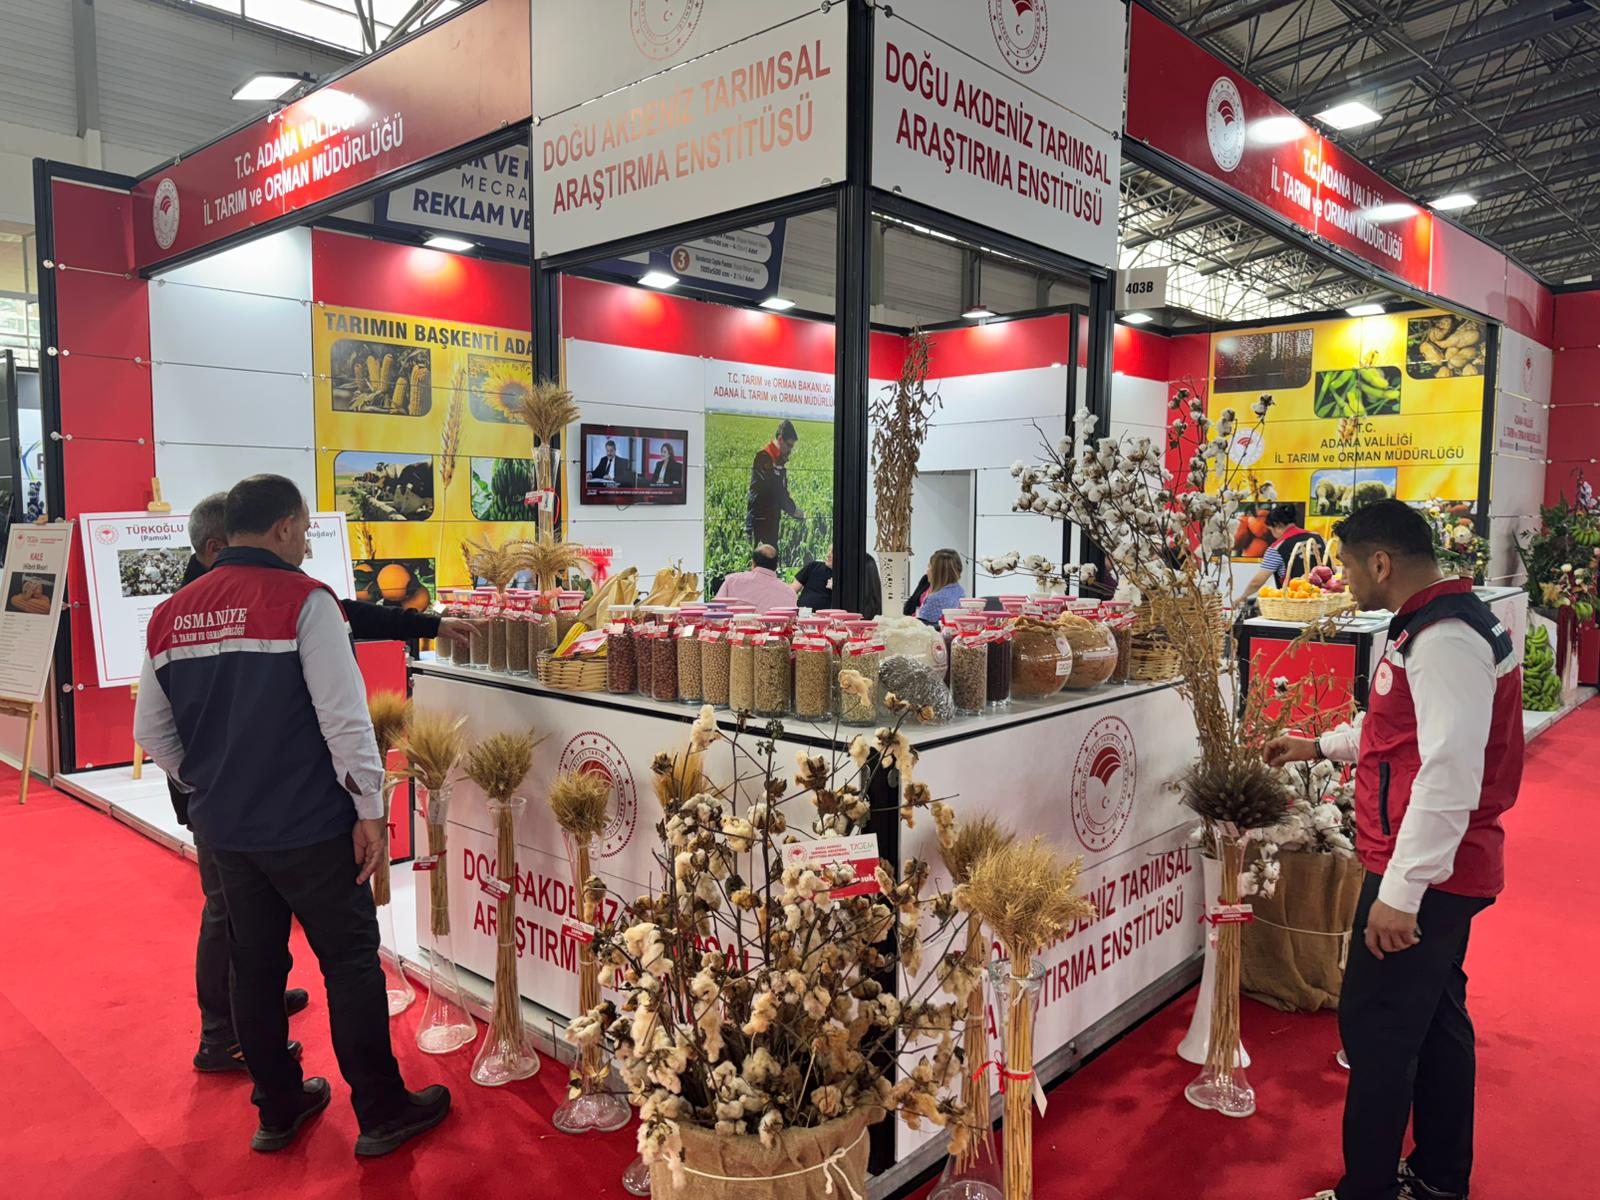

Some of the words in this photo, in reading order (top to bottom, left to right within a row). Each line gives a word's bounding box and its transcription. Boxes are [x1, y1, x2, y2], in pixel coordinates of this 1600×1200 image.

[543, 121, 596, 172] DOĞU
[601, 84, 694, 153] AKDENİZ
[700, 39, 831, 115] TARIMSAL
[885, 42, 949, 107] DOĞU
[953, 79, 1033, 149] AKDENİZ
[1037, 121, 1111, 185] TARIMSAL
[203, 195, 213, 226] İL
[214, 188, 247, 221] TARIM
[249, 187, 262, 207] ve
[265, 160, 310, 202] ORMAN
[312, 112, 404, 182] MÜDÜRLÜĞÜ
[234, 156, 254, 179] T.C.
[257, 131, 299, 170] ADANA
[552, 152, 669, 214] ARAŞTIRMA
[676, 92, 813, 179] ENSTİTÜSÜ
[895, 107, 1013, 190] ARAŞTIRMA
[1017, 162, 1101, 226] ENSTİTÜSÜ
[1271, 157, 1280, 192] İL
[1282, 171, 1312, 211] TARIM
[1312, 196, 1322, 217] ve
[1324, 198, 1355, 236] ORMAN
[1320, 161, 1351, 200] ADANA
[413, 188, 504, 226] REKLAM
[678, 251, 686, 270] 3
[1124, 281, 1154, 295] 403B
[325, 312, 407, 340] TARIMIN
[415, 324, 499, 352] BAŞKENTİ
[713, 386, 739, 398] ADANA
[748, 389, 769, 401] TARIM
[779, 393, 802, 404] ORMAN
[742, 374, 762, 385] TARIM
[773, 378, 797, 389] ORMAN
[1320, 437, 1362, 449] ADANA
[1364, 432, 1413, 447] VALİLİĞİ
[1356, 423, 1376, 433] T.C.
[1274, 452, 1286, 464] İL
[1288, 452, 1320, 464] TARIM
[1323, 454, 1335, 463] ve
[1338, 450, 1382, 463] ORMAN
[1386, 446, 1465, 462] MÜDÜRLÜĞÜ
[125, 523, 184, 535] TÜRKOĞLU
[140, 534, 171, 542] (Pamuk)
[174, 605, 248, 631] OSMANİYE
[1120, 844, 1193, 908] TARIMSAL
[1101, 885, 1185, 971] ENSTİTÜSÜ
